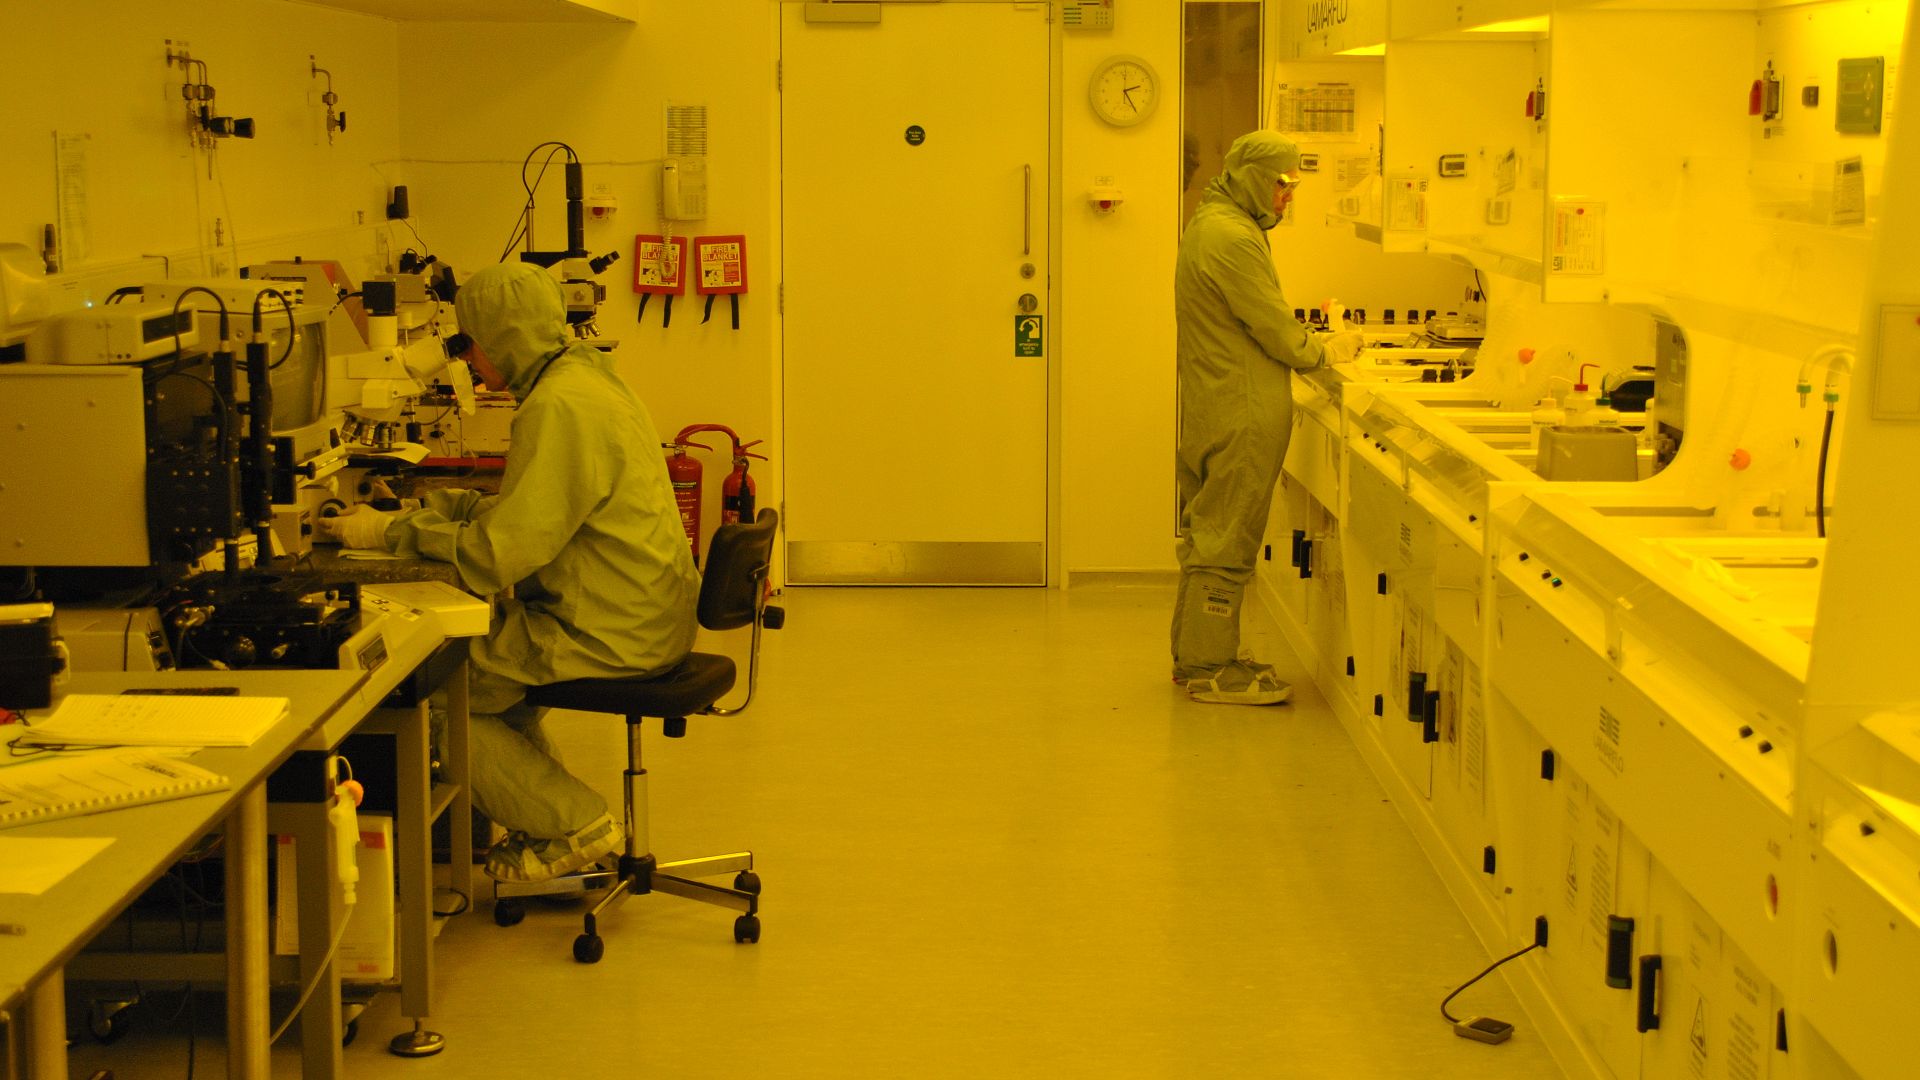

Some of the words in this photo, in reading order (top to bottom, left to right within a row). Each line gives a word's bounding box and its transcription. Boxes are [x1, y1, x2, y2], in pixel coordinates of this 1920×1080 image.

[652, 245, 669, 253] FIR
[712, 245, 728, 254] FIRE
[703, 252, 738, 262] BLANKET
